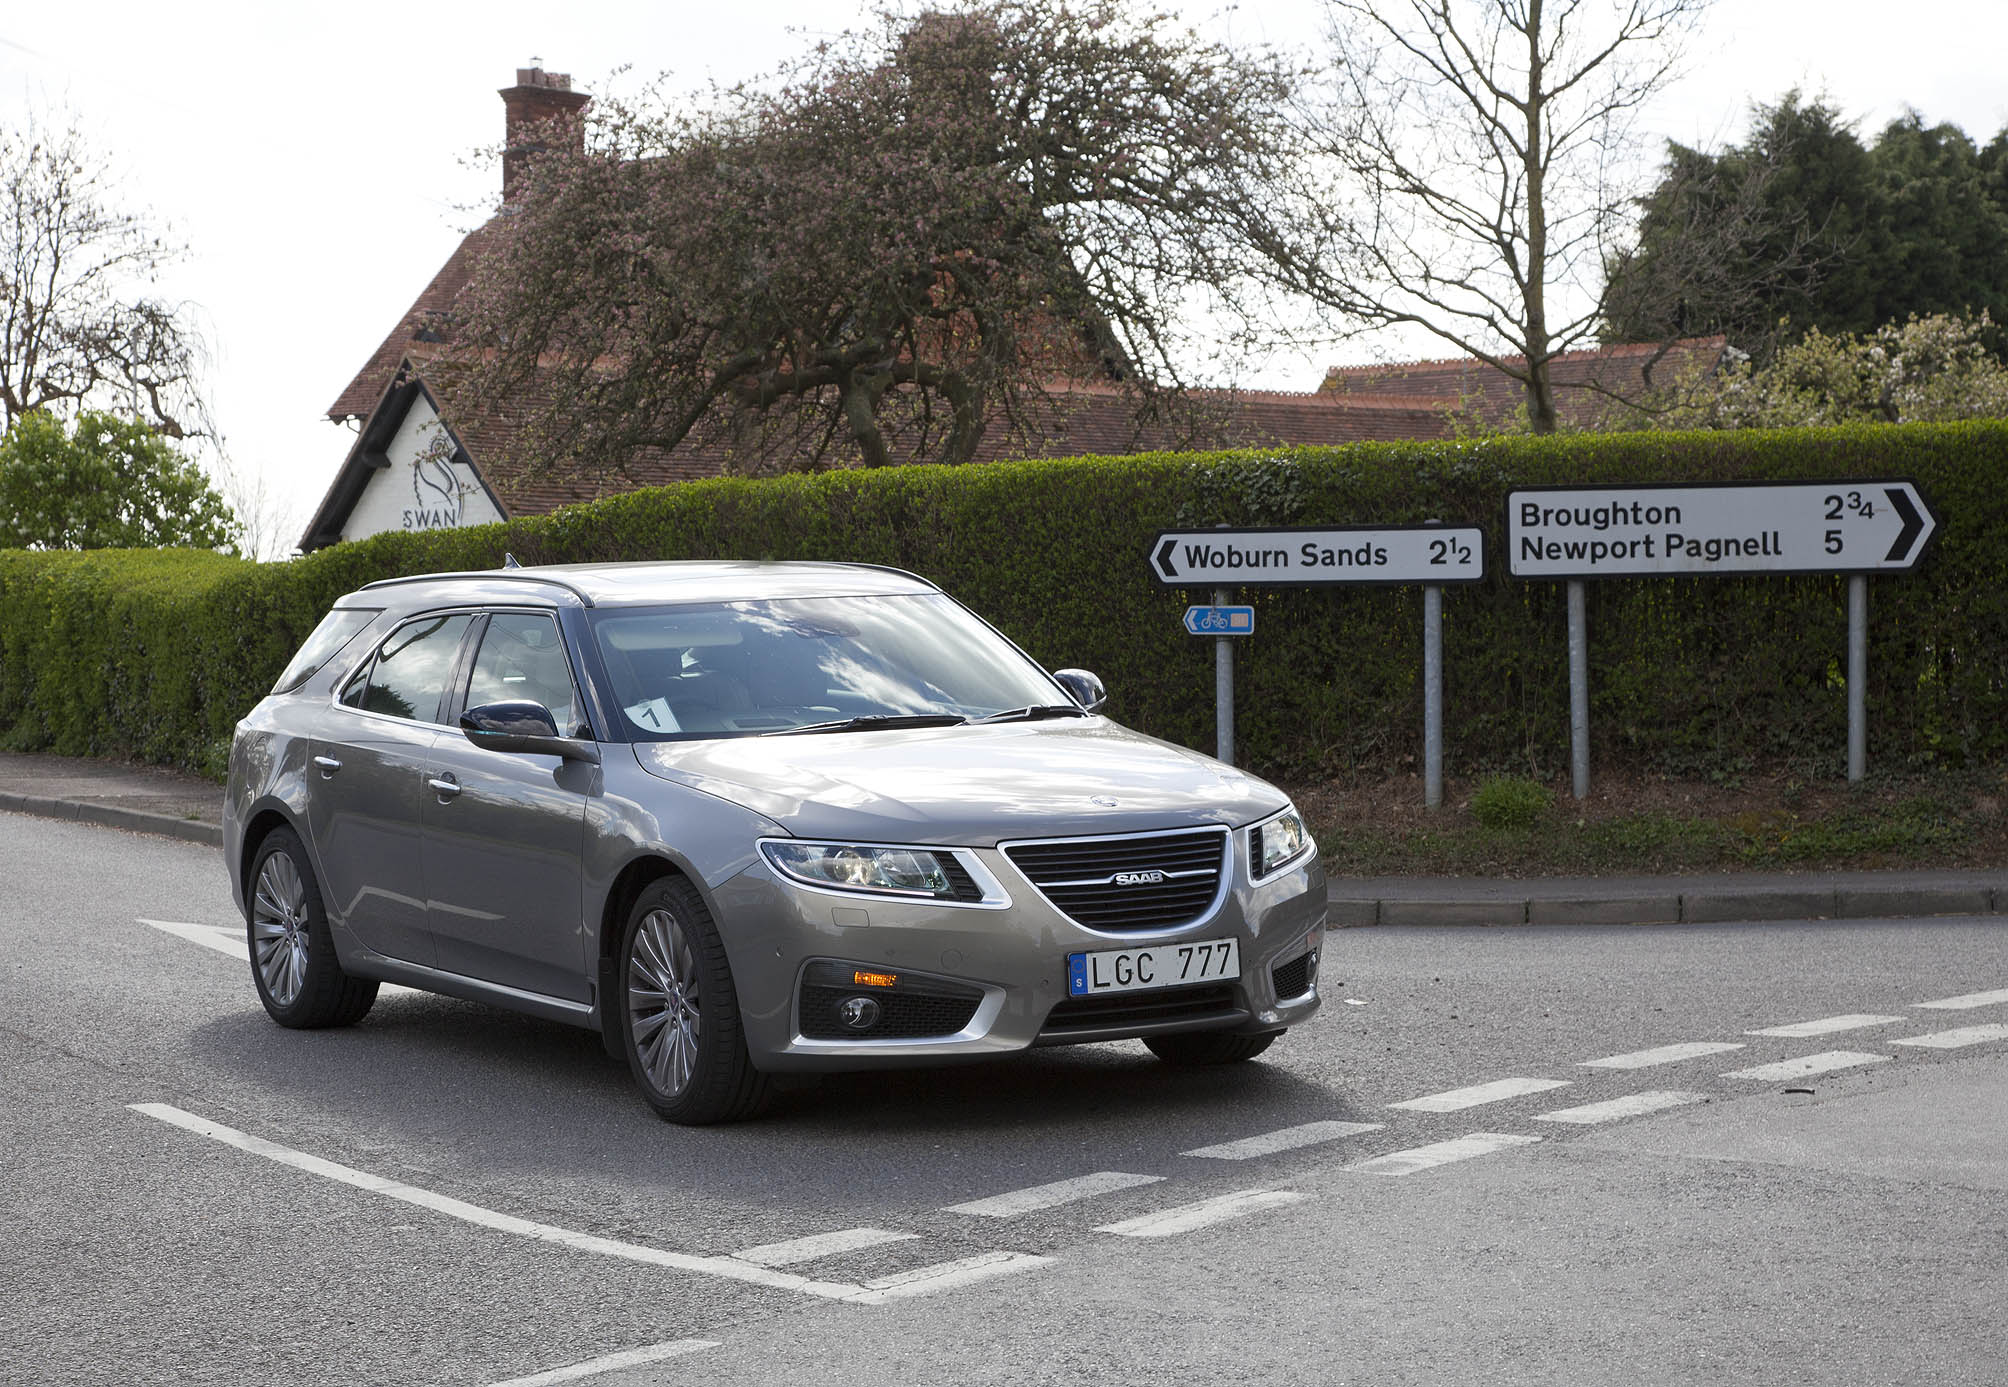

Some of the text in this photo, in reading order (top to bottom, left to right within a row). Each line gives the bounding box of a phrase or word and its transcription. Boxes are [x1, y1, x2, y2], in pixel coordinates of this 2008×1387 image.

[402, 509, 456, 528] SWAN
[1520, 502, 1681, 531] Broughton
[1185, 543, 1288, 569] Woburn
[1300, 542, 1388, 567] Sands
[1521, 529, 1844, 564] Newport Pagnell 5
[642, 707, 661, 727] 1
[1115, 872, 1164, 886] SAAB
[1093, 943, 1231, 988] LGC 777
[1076, 978, 1082, 988] S
